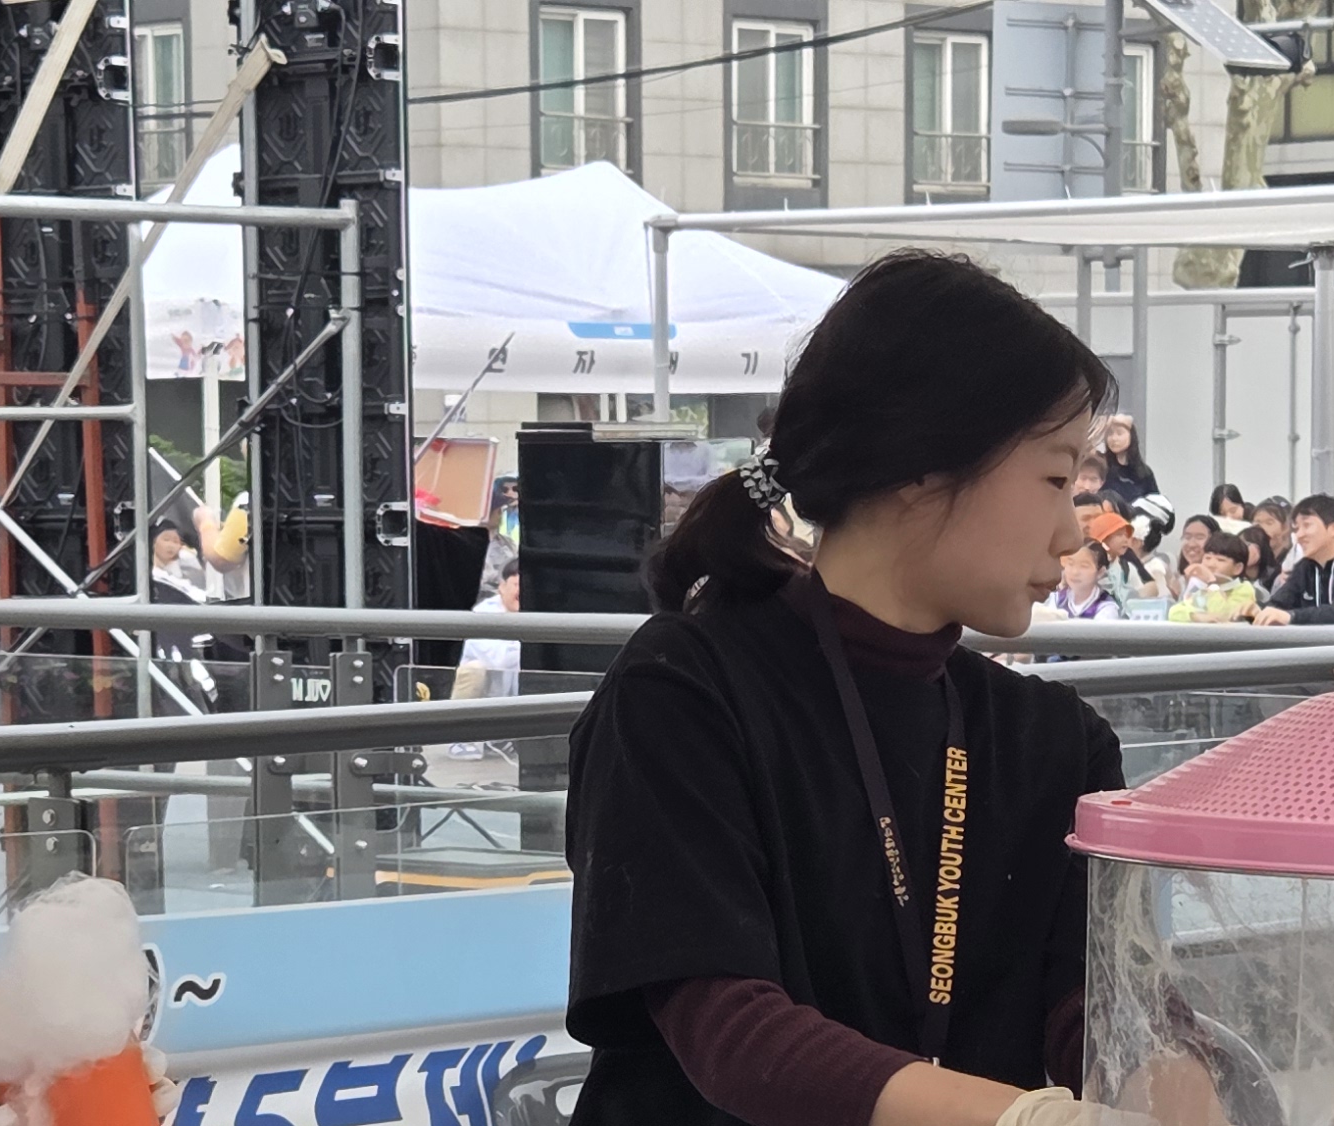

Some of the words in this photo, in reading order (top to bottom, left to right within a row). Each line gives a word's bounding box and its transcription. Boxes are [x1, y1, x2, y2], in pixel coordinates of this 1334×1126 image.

[942, 745, 969, 824] CENTER
[936, 824, 966, 893] YOUTH
[928, 894, 960, 1006] SEONGBUK
